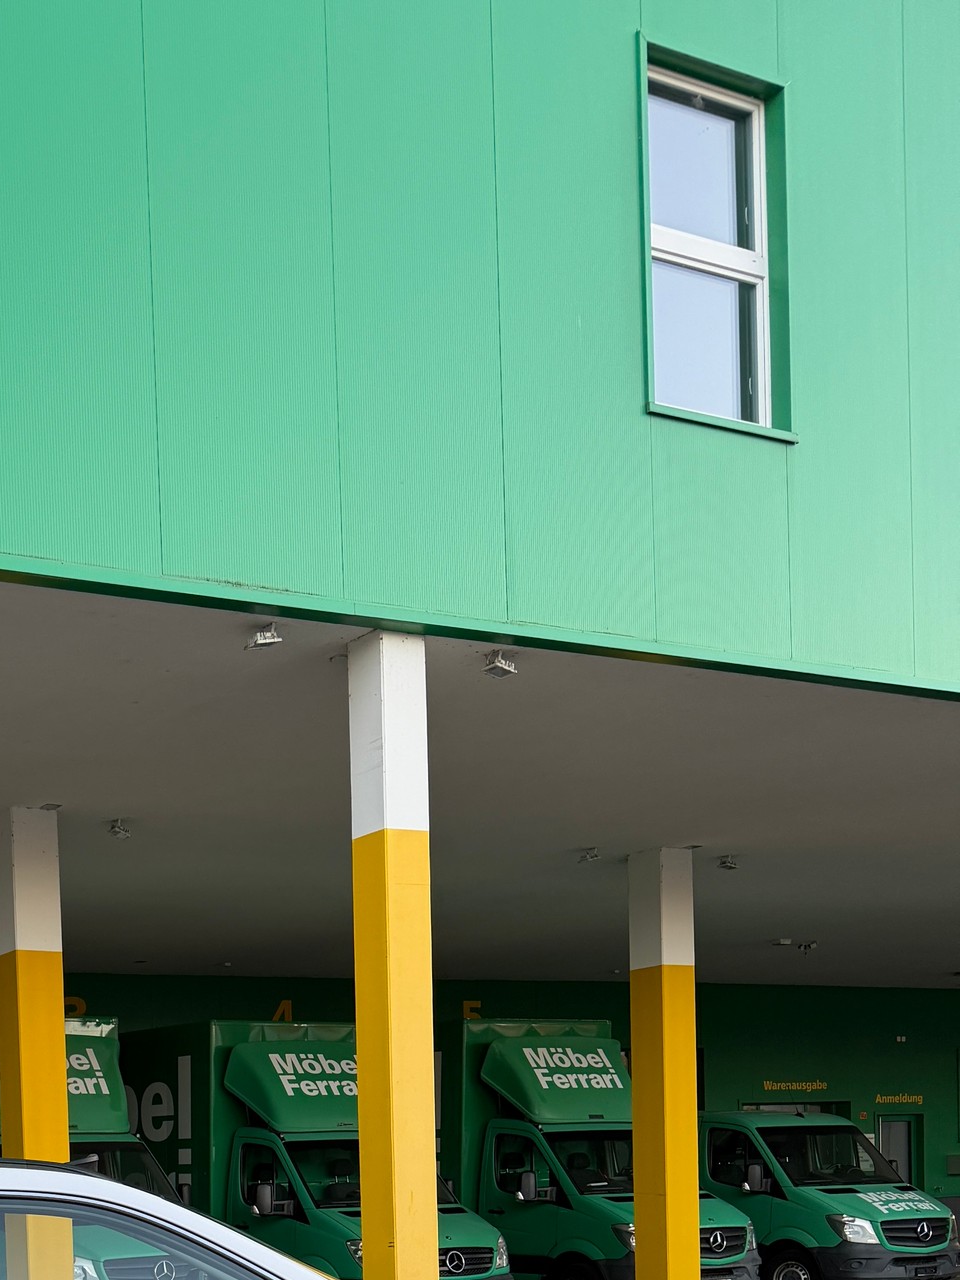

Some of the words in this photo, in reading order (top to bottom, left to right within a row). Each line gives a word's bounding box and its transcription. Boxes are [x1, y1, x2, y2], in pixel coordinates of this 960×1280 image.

[268, 1053, 358, 1075] Möbe
[522, 1047, 612, 1069] Möbel
[278, 1075, 359, 1096] Ferra
[533, 1069, 624, 1090] Ferrari
[763, 1080, 828, 1093] Warenausgabe
[875, 1093, 923, 1105] Anmeldung
[856, 1191, 929, 1204] Möbel
[872, 1201, 941, 1214] Ferrari
